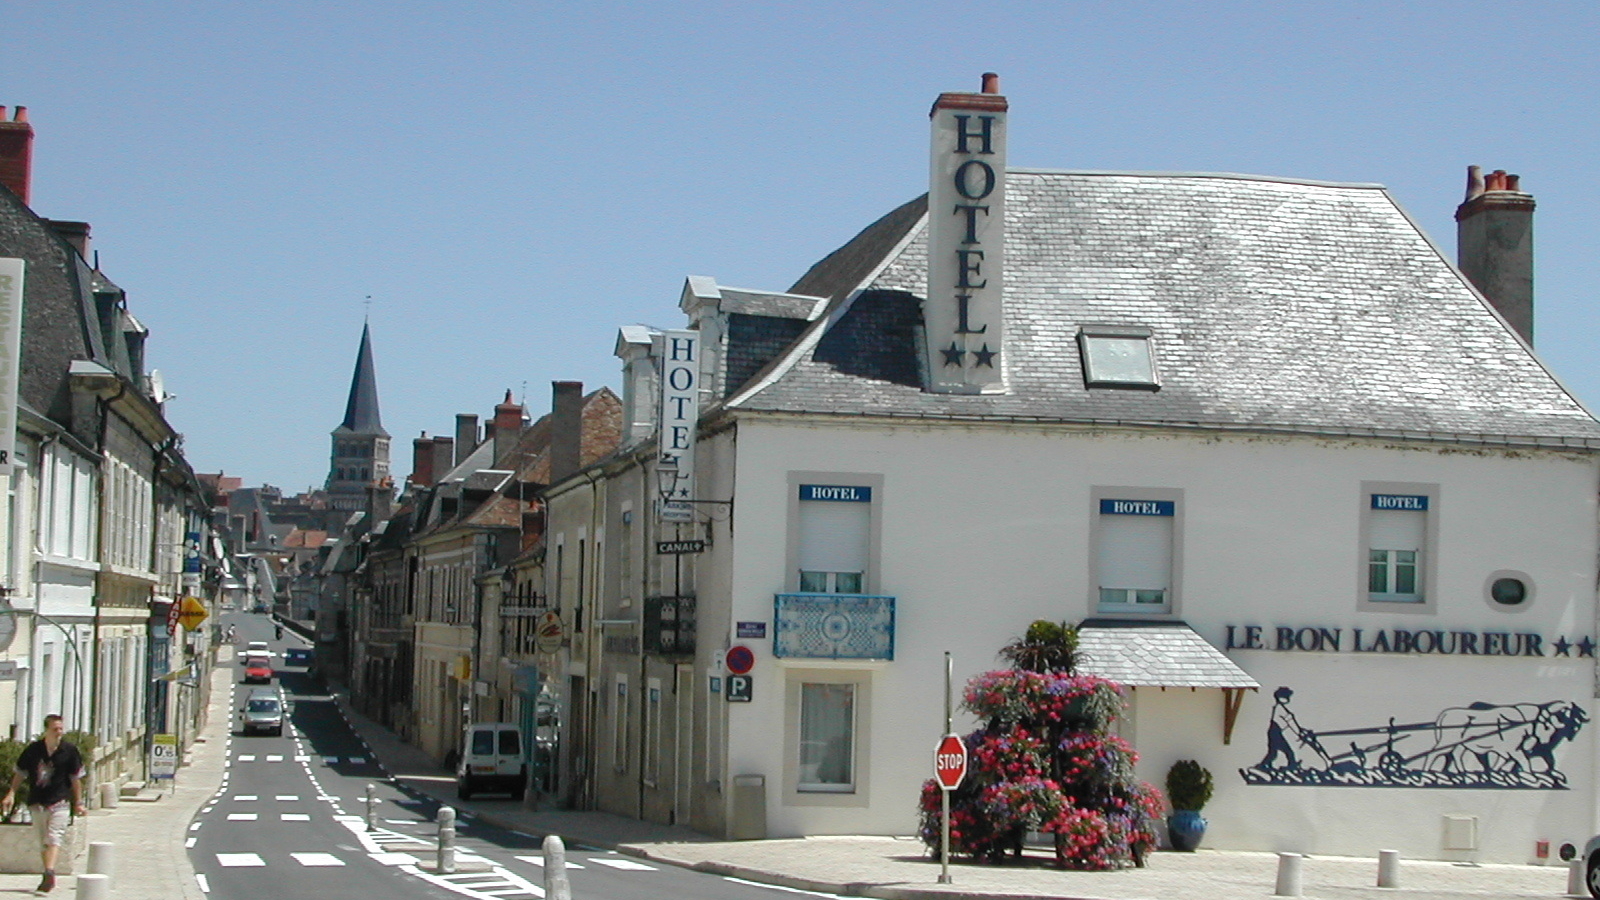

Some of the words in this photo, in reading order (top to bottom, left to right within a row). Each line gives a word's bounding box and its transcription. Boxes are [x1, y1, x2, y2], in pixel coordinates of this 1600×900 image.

[953, 115, 996, 334] HOTEL
[669, 338, 695, 479] HOTEL
[812, 486, 860, 500] HOTEL
[1114, 501, 1161, 515] HOTEL
[1377, 495, 1422, 509] HOTEL
[660, 543, 702, 553] CANAL+
[1226, 625, 1263, 650] LE
[1276, 626, 1343, 652] BON
[1353, 628, 1545, 657] LABOUREUR
[732, 677, 747, 695] P
[938, 753, 963, 770] STOP
